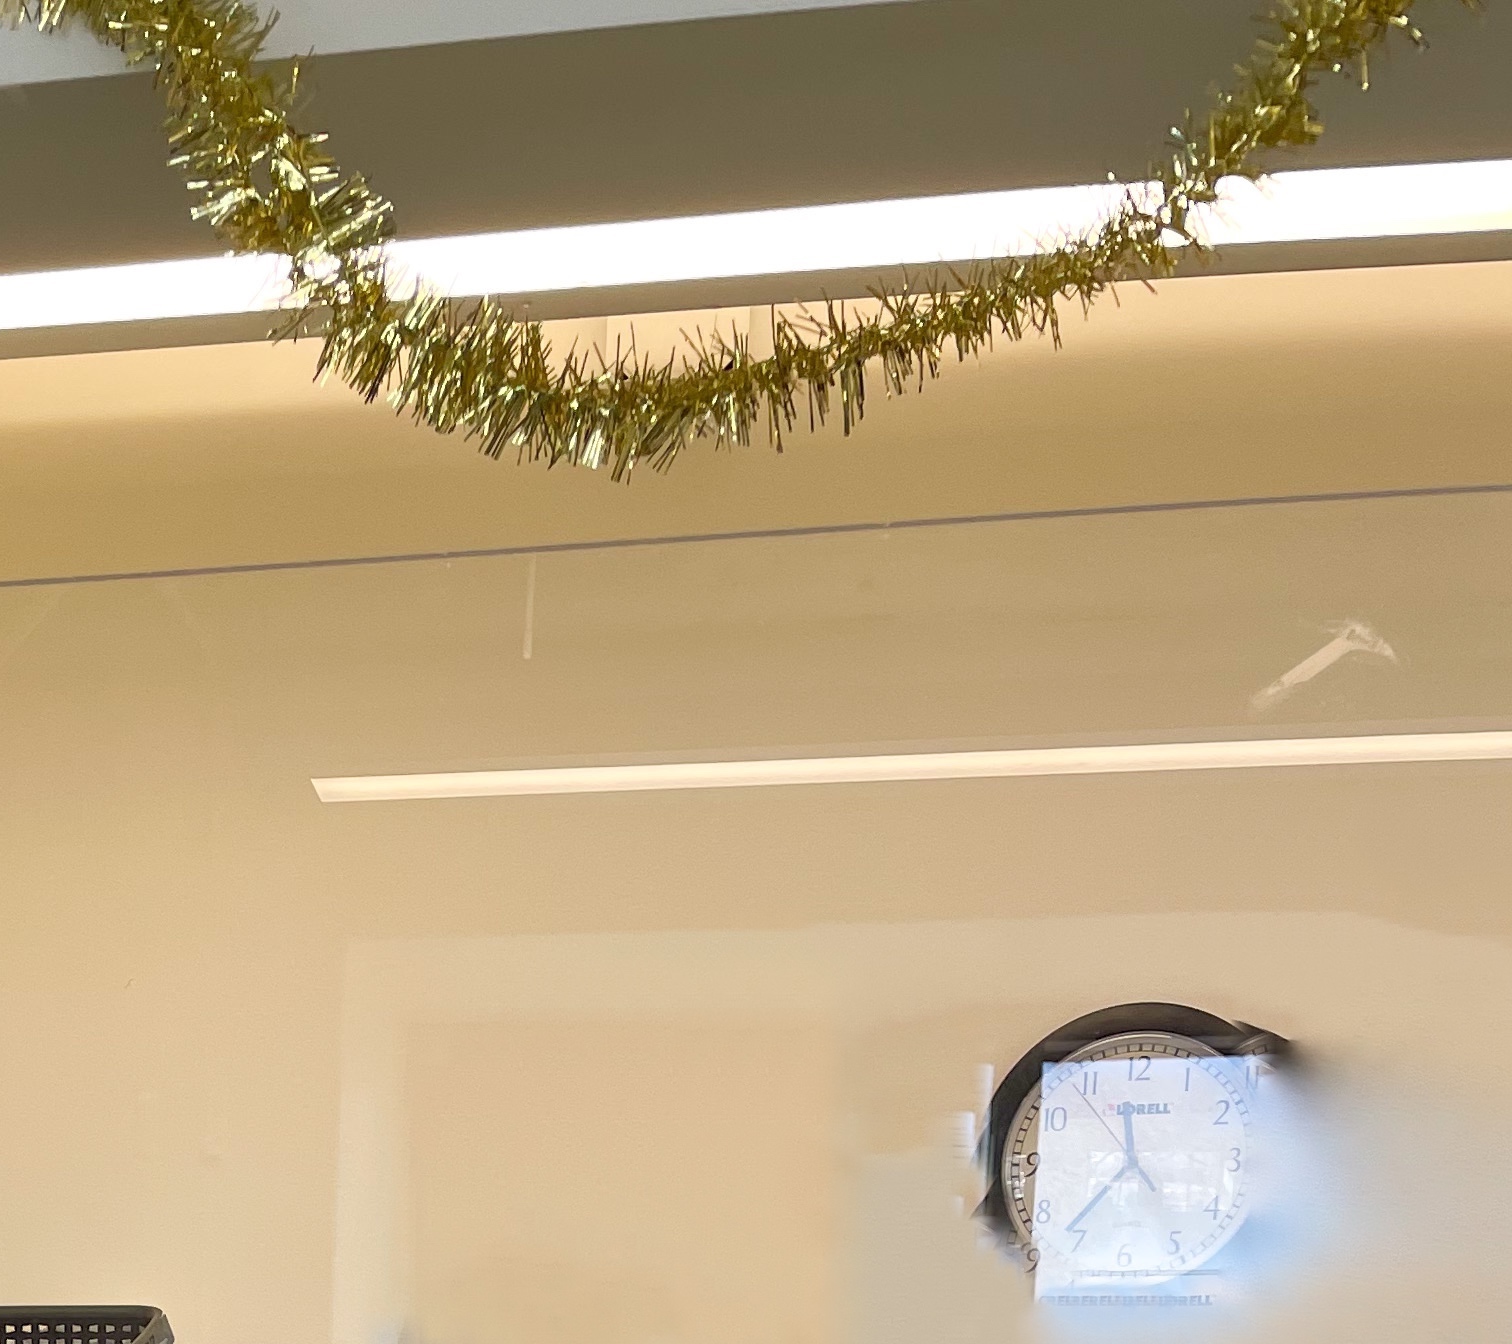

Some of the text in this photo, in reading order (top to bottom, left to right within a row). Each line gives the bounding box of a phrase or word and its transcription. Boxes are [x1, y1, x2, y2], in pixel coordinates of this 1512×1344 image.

[1128, 1056, 1151, 1081] 12
[1184, 1067, 1190, 1092] 1
[1083, 1072, 1098, 1095] 11
[1044, 1107, 1068, 1132] 10
[1213, 1100, 1230, 1125] 2
[1025, 1152, 1040, 1177] 9
[1227, 1148, 1241, 1172] 3
[1036, 1200, 1051, 1223] 8
[1203, 1195, 1220, 1220] 4
[1071, 1230, 1086, 1253] 7
[1168, 1231, 1182, 1254] 5
[1117, 1244, 1132, 1267] 6
